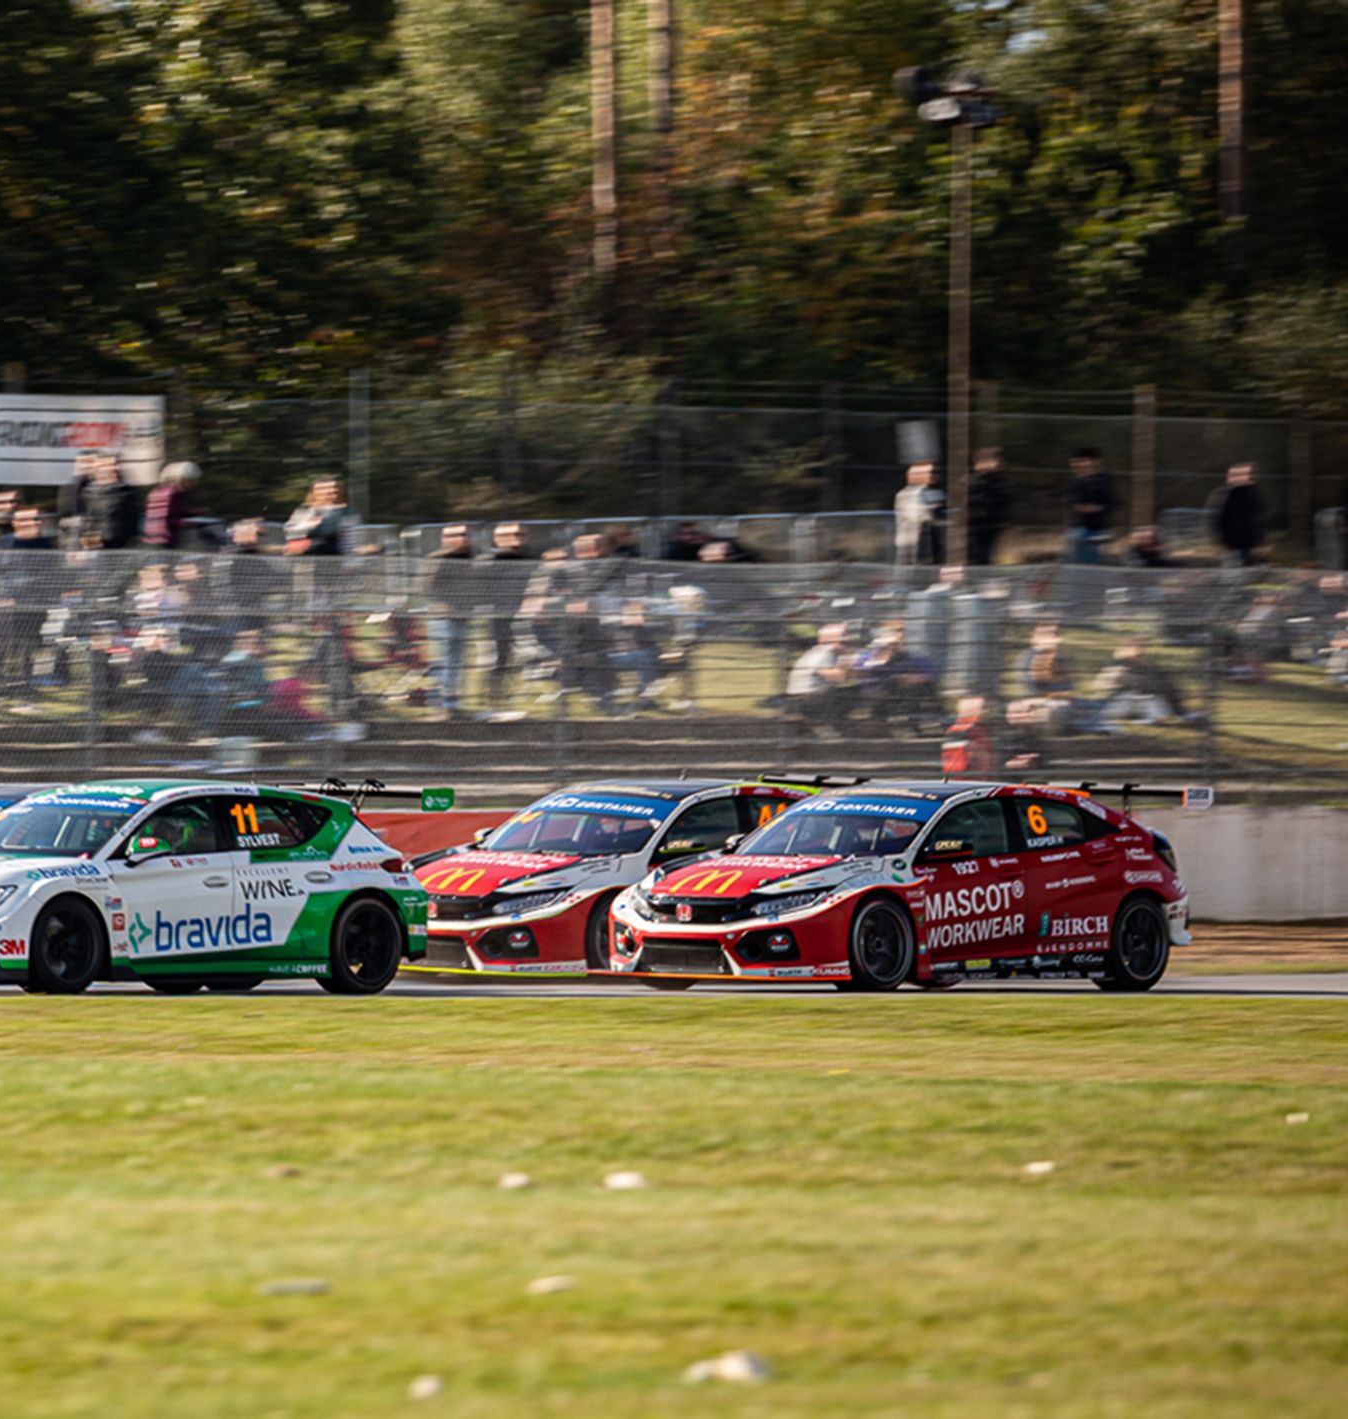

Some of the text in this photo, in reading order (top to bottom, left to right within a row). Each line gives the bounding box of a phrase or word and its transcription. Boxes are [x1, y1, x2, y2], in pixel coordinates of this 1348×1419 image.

[230, 803, 260, 834] 11
[575, 801, 655, 816] CONTAINER
[834, 803, 917, 816] CONTAINER
[1026, 804, 1048, 835] 6
[236, 832, 281, 848] SYLVEST
[155, 902, 273, 952] bravida
[926, 913, 1025, 950] WORKWEAR
[1051, 914, 1109, 937] BIRCH
